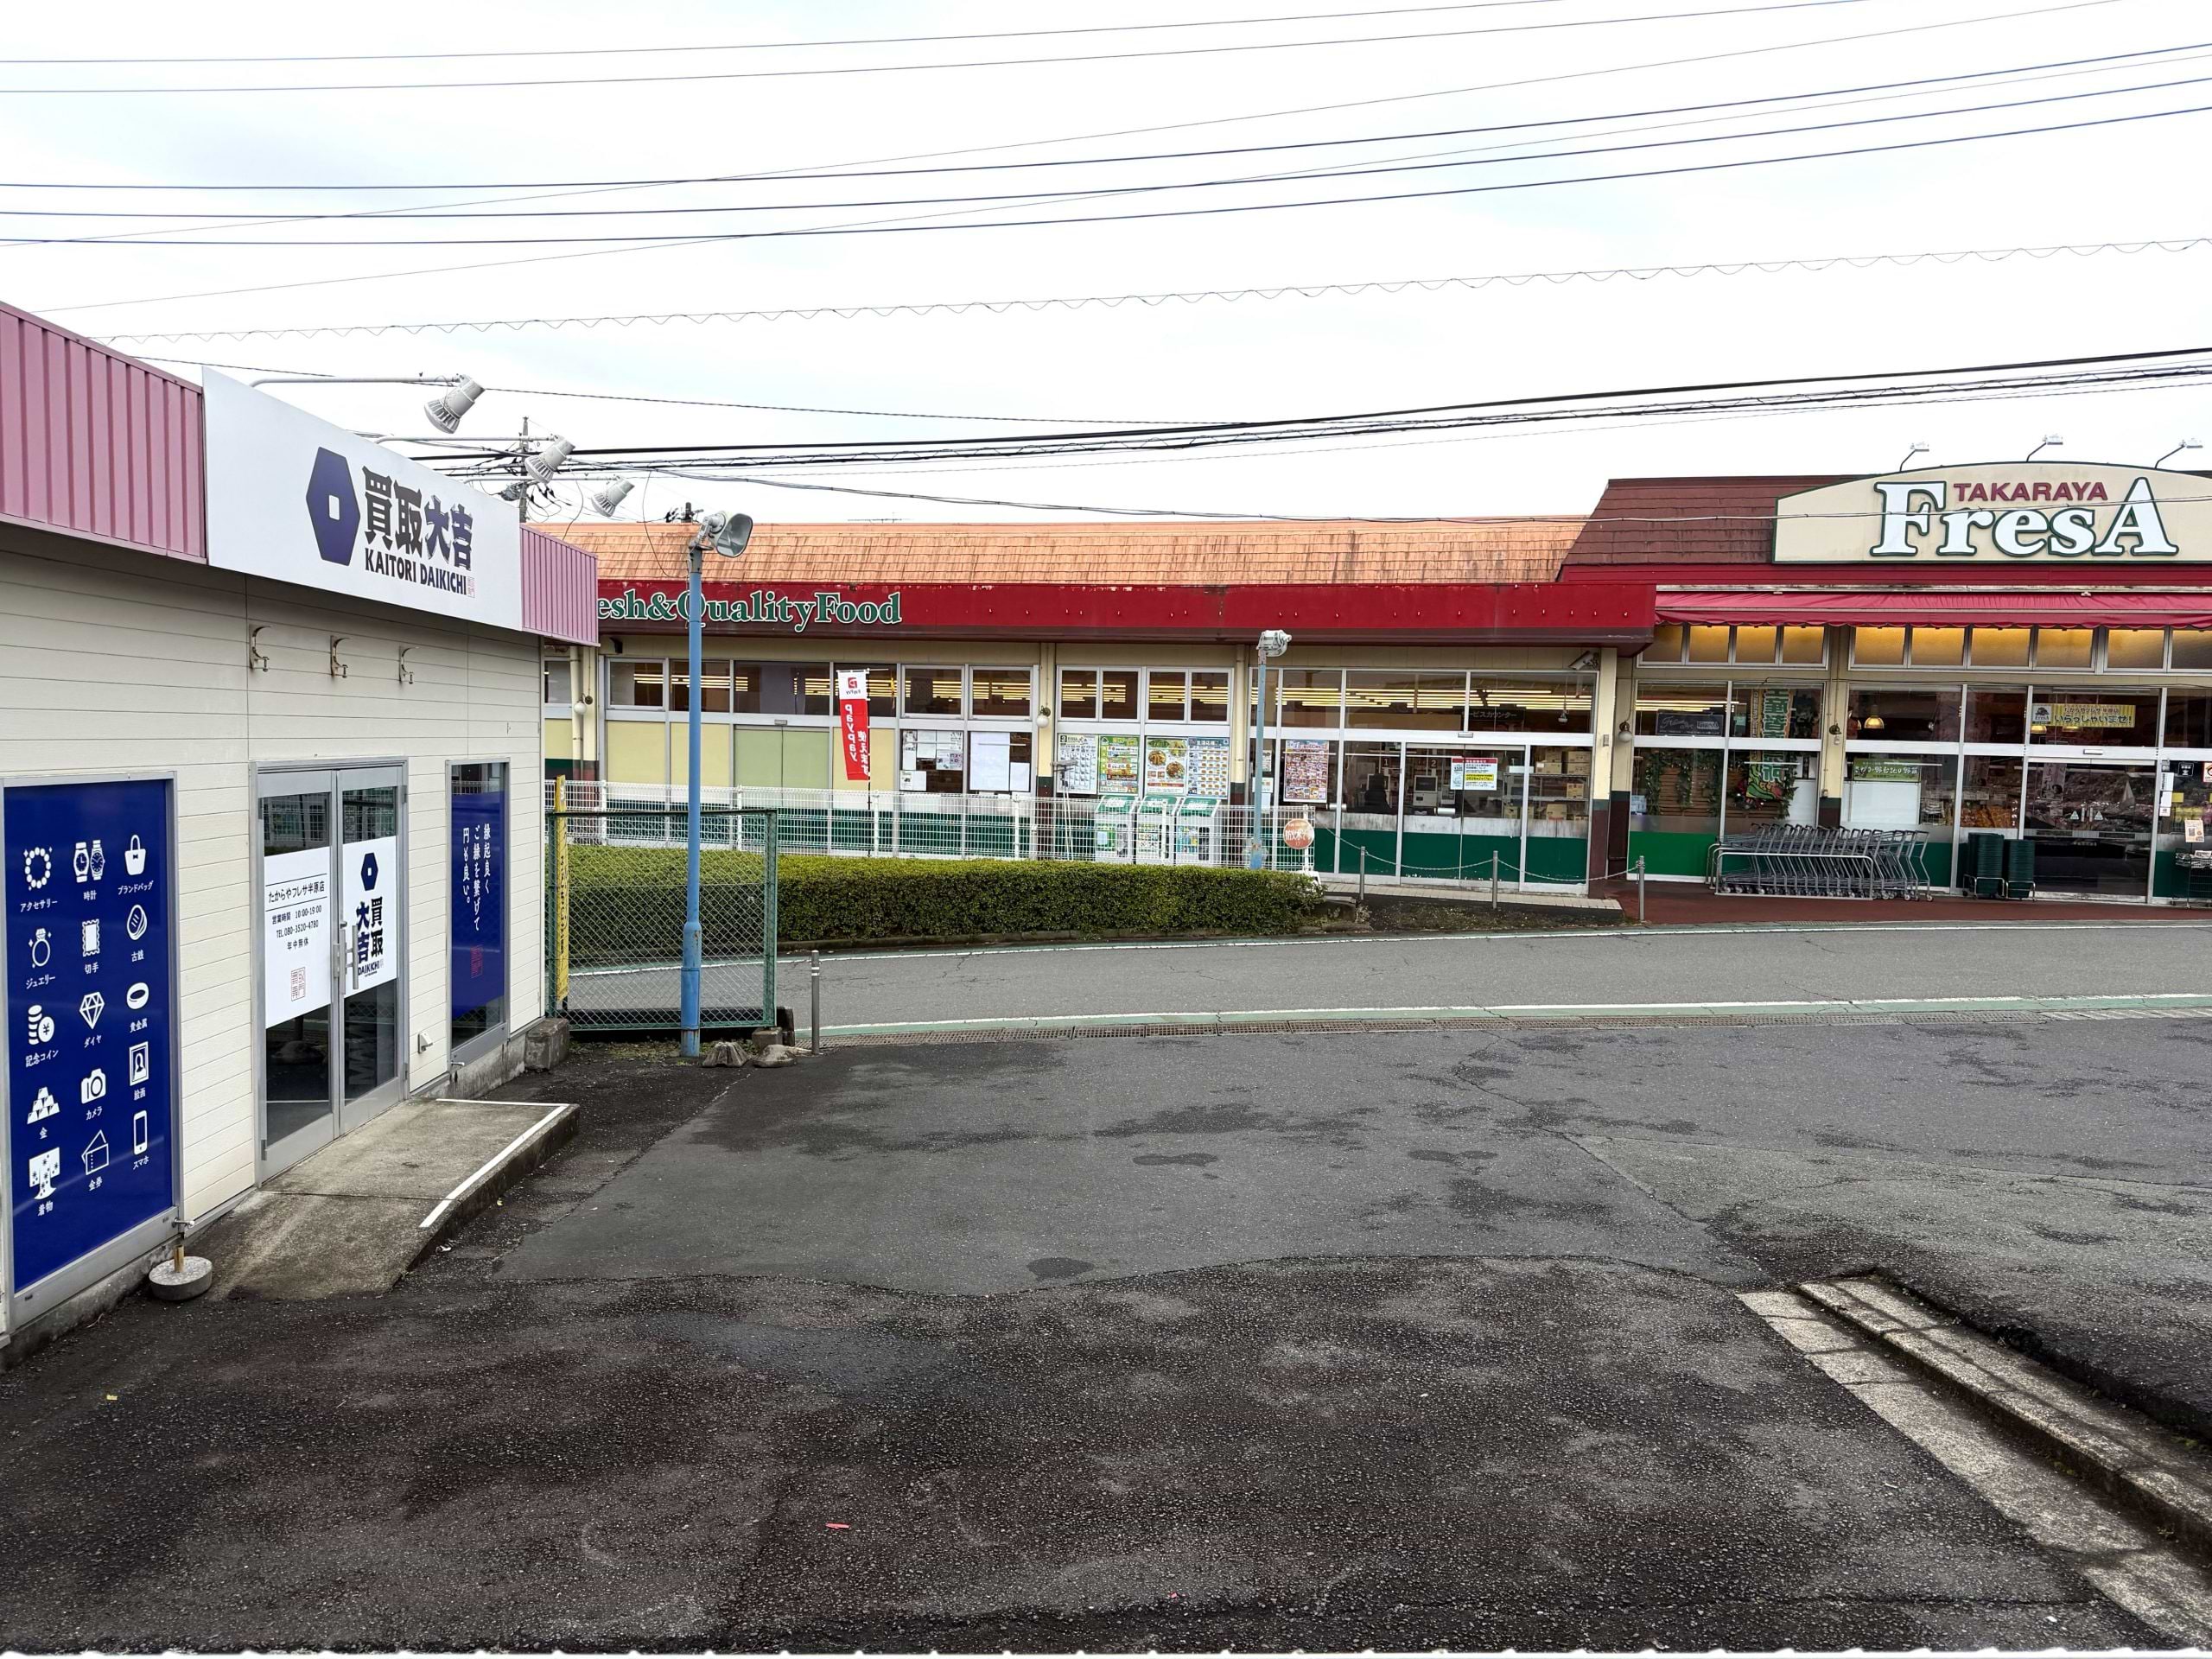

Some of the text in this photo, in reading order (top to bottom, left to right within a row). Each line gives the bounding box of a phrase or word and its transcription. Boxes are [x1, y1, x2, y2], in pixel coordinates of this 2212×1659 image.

[1953, 481, 2108, 502] TAKARAYA
[361, 465, 474, 572] 買取大吉
[1869, 476, 2180, 557] FresA
[365, 547, 416, 583] KAITORI
[420, 563, 467, 596] DAIKICHI
[462, 827, 471, 904] 円も良い。
[473, 824, 481, 931] ご縁を繋げて
[118, 880, 154, 895] ブランドバッグ
[269, 880, 325, 904] たからやフレサ半原店
[83, 890, 98, 901] 時計
[20, 899, 58, 912] アクセサリー
[272, 912, 291, 925] 営業時間
[356, 901, 370, 964] 大吉
[371, 896, 383, 957] 買取
[287, 938, 309, 951] 年中無休
[84, 963, 99, 975] 切手
[25, 974, 56, 989] ジュエリー
[130, 1018, 148, 1033] 貴金属
[84, 1034, 102, 1048] ダイヤ
[25, 1049, 59, 1068] 記念コイン
[86, 1106, 103, 1121] カメラ
[39, 1127, 48, 1140] 金
[132, 1155, 149, 1170] スマホ
[88, 1176, 103, 1192] 金券
[37, 1200, 54, 1217] 着物
